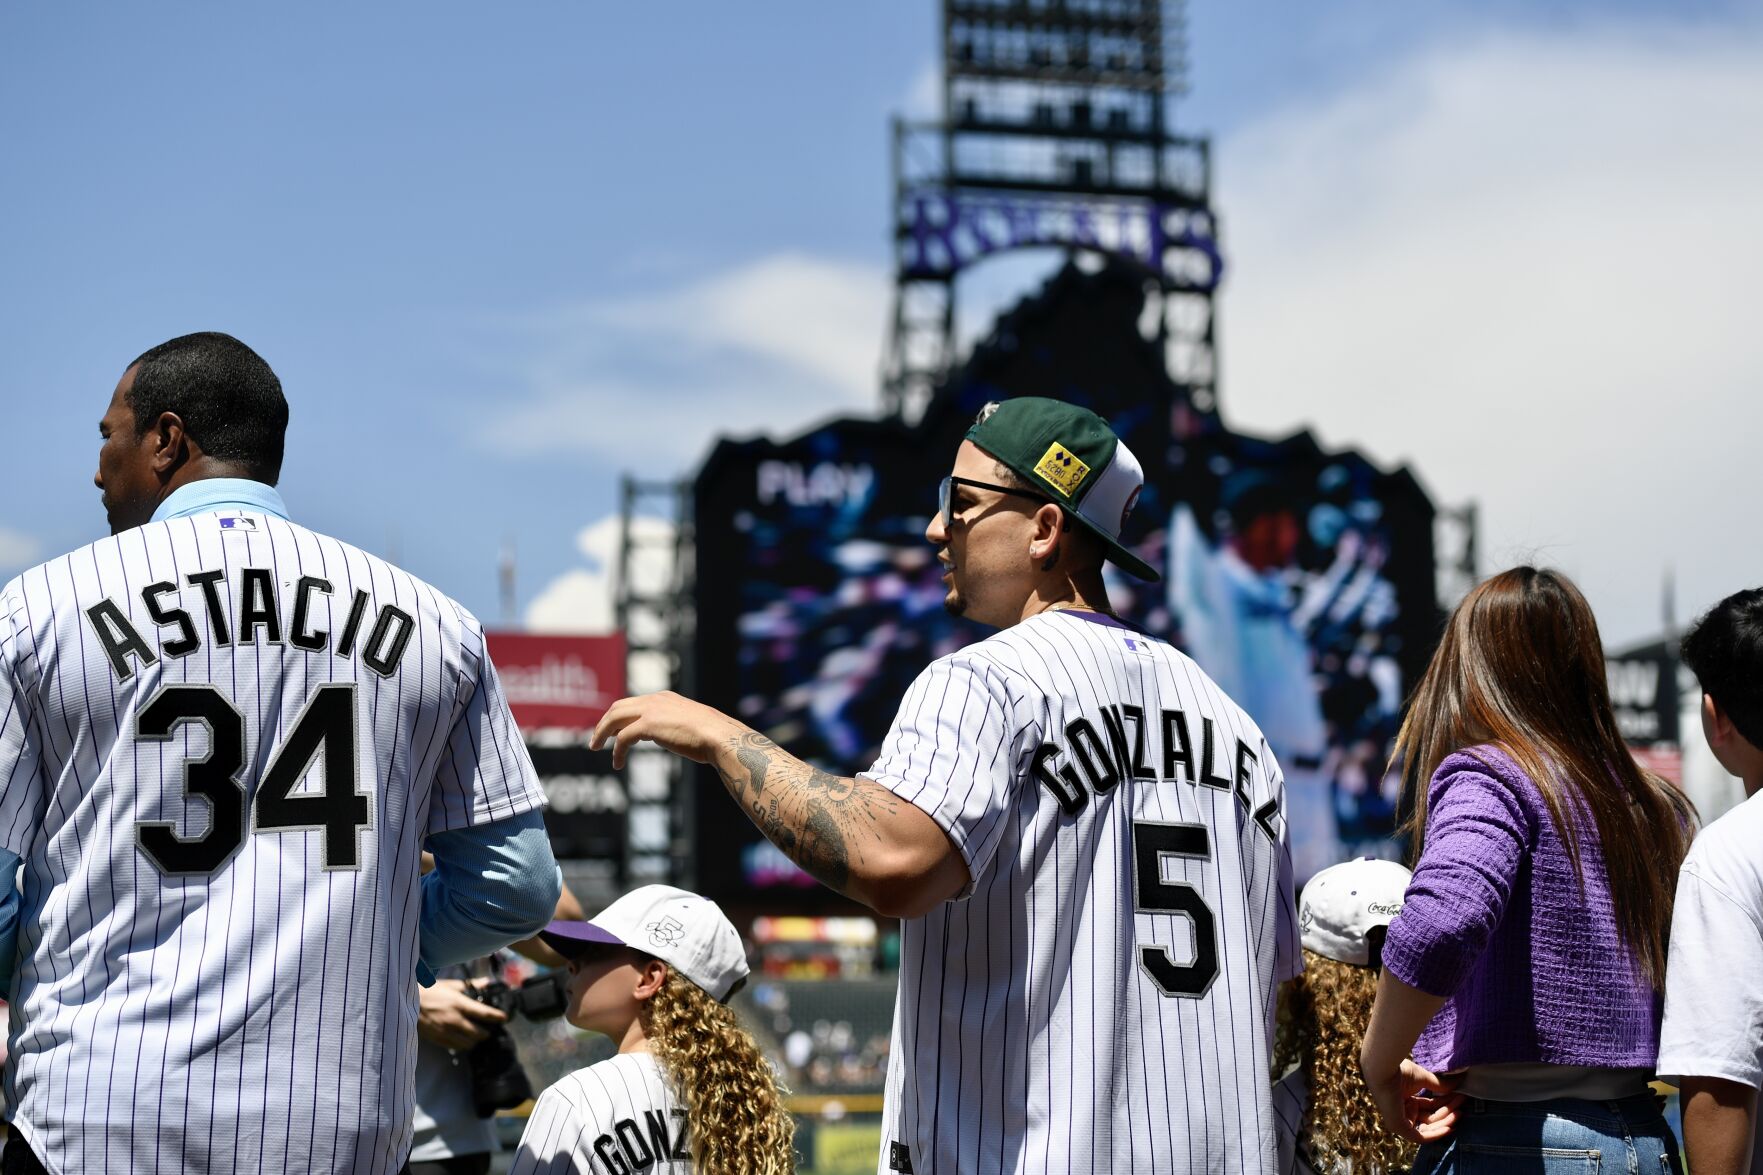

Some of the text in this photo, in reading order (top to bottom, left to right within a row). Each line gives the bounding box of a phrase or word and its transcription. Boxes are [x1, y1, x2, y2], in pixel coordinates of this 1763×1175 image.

[756, 459, 874, 507] PLAY
[1066, 465, 1086, 488] ROX
[82, 567, 417, 684] ASTACIO
[133, 682, 373, 877] 34
[752, 801, 767, 819] 5
[1133, 818, 1221, 1000] 5
